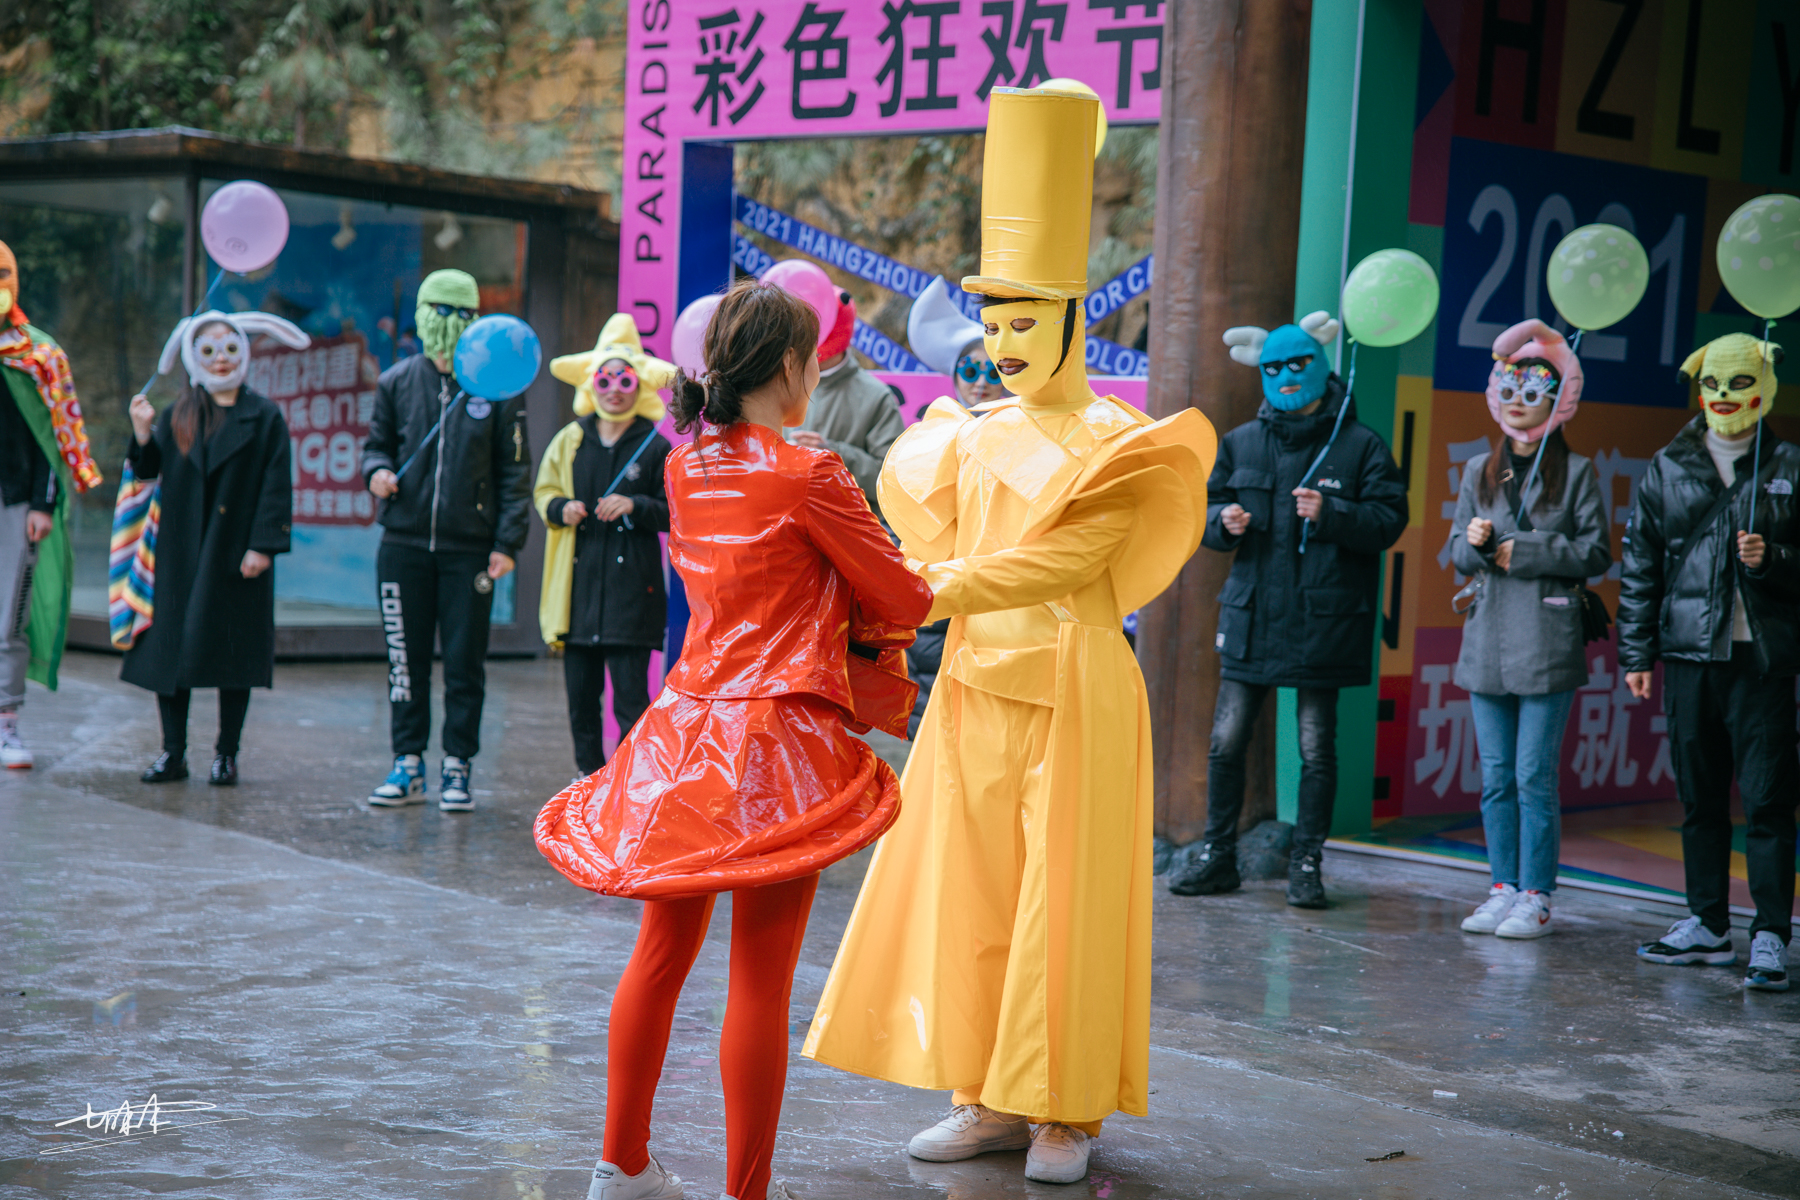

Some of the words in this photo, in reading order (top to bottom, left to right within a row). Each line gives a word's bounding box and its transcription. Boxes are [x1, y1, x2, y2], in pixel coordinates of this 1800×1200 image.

[693, 0, 1164, 127] 彩色狂欢节
[732, 238, 772, 279] 202
[852, 320, 909, 373] HOU
[742, 200, 791, 243] 2021
[797, 225, 928, 299] HANGZHOU
[1086, 278, 1127, 324] OR
